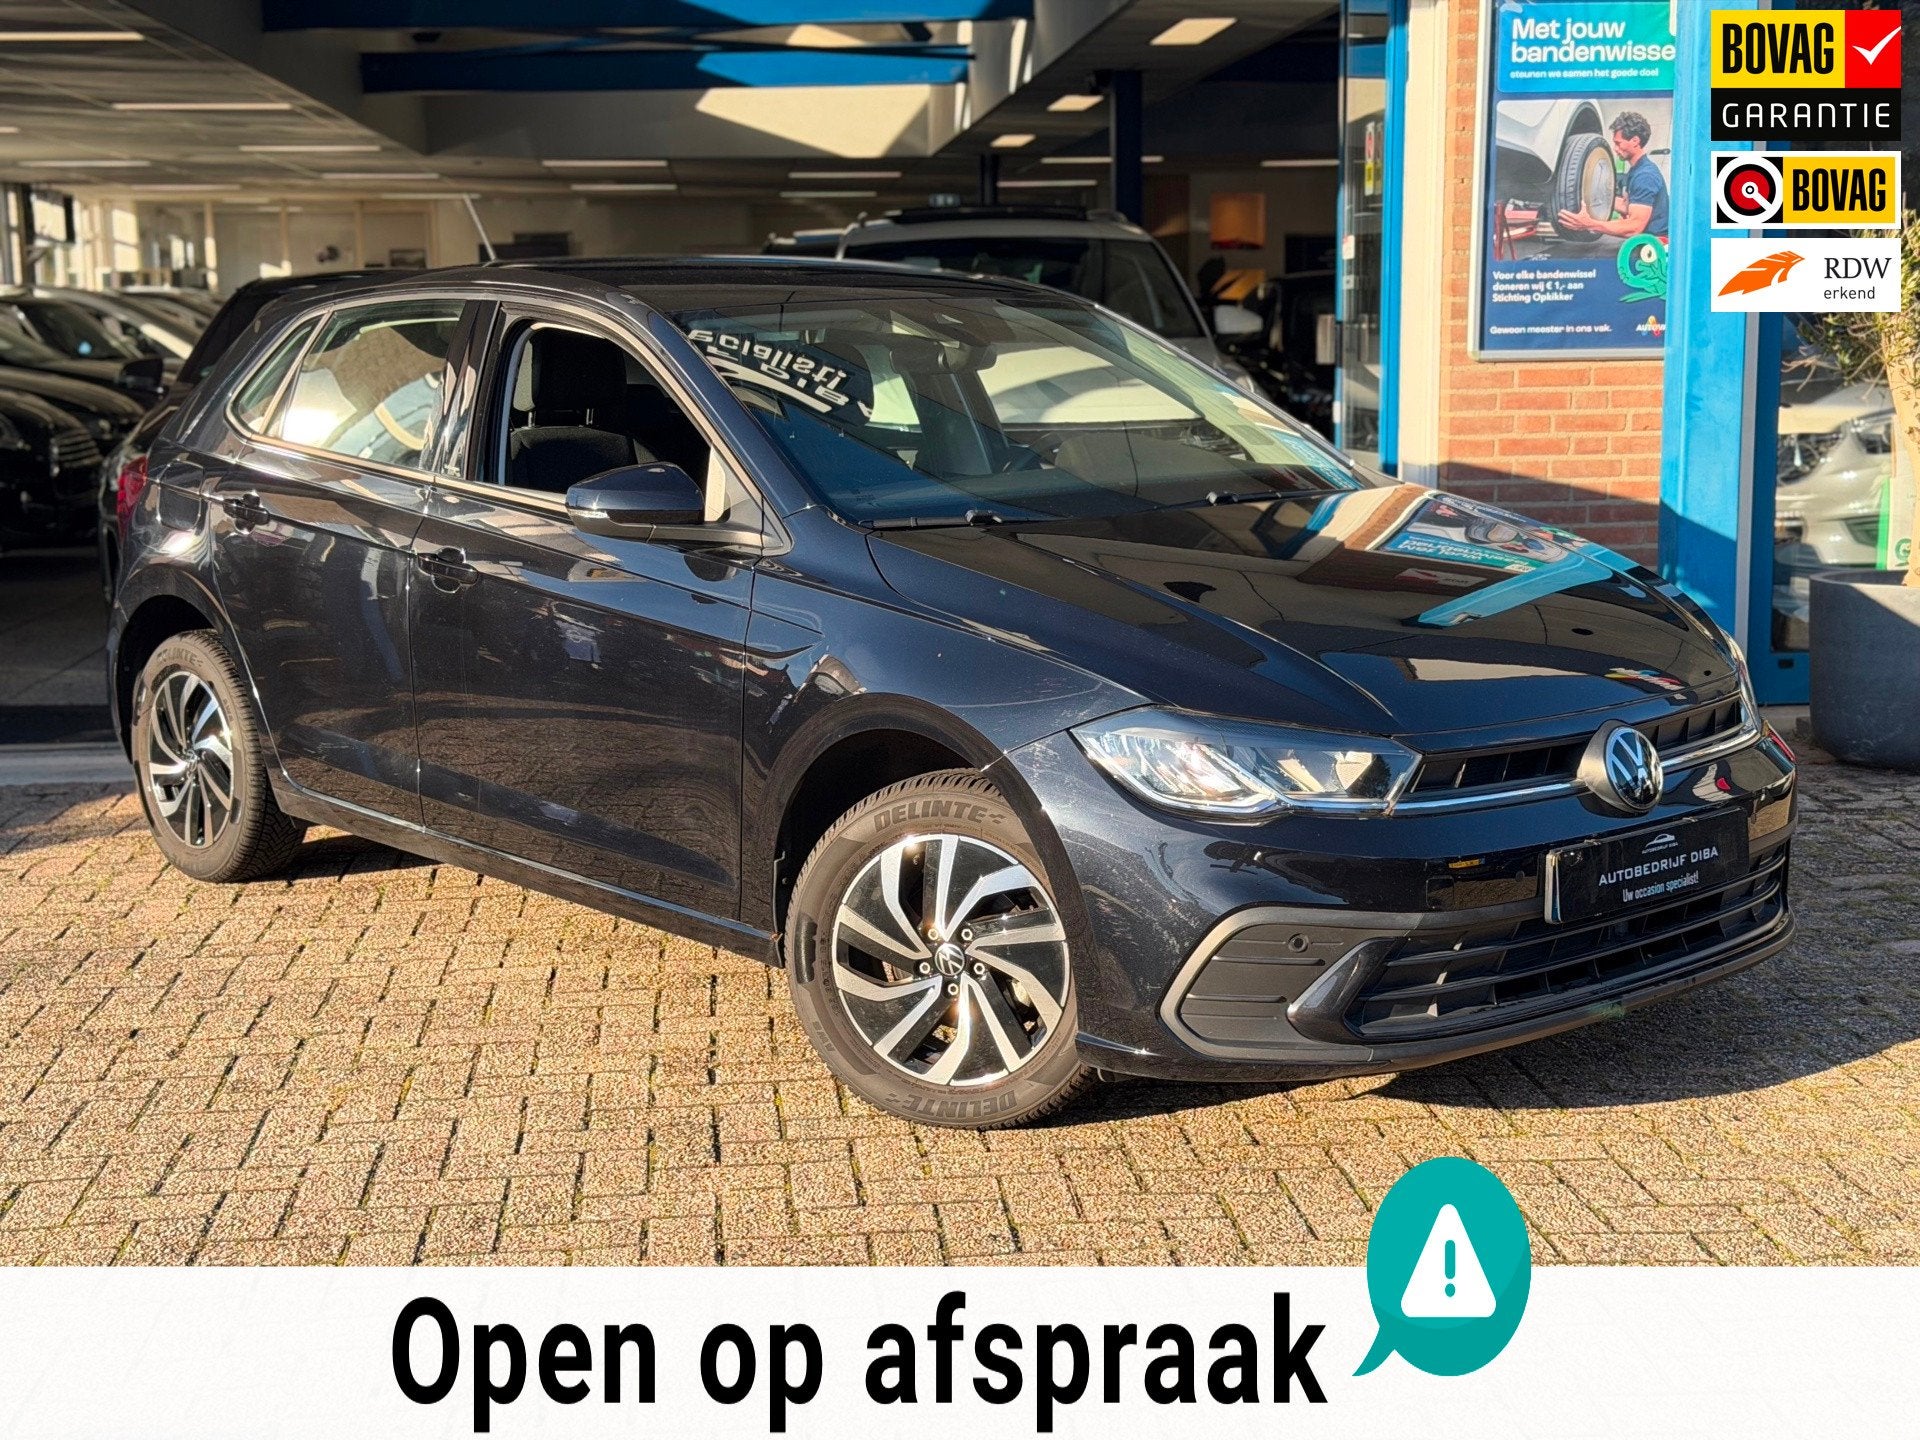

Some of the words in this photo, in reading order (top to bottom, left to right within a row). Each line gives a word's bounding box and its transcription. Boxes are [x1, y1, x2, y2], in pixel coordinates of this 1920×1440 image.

[1512, 18, 1561, 39] Met
[1562, 17, 1626, 45] jouw
[1510, 70, 1547, 79] steunen
[1562, 70, 1593, 78] samen
[1594, 68, 1610, 78] het
[1610, 68, 1638, 79] goede
[1639, 68, 1659, 77] doel
[1492, 271, 1514, 280] Voor
[1515, 270, 1535, 280] elke
[1536, 269, 1597, 279] bandenwissel
[1492, 282, 1530, 291] doneren
[1531, 282, 1545, 292] wij
[1567, 282, 1584, 290] aan
[1492, 292, 1531, 303] Stichting
[1532, 292, 1574, 302] Opkikker
[1489, 325, 1526, 335] Gewoon
[1527, 324, 1564, 334] meester
[1565, 324, 1575, 333] in
[1575, 325, 1592, 333] ons
[1593, 323, 1613, 333] vak.
[874, 800, 988, 833] DELINTE
[1598, 853, 1688, 886] AUTOBEDRIJF
[1690, 846, 1719, 863] DIBA
[1622, 888, 1634, 903] Uw
[1634, 882, 1665, 899] occasion
[1665, 870, 1699, 893] specialist!
[904, 1090, 1018, 1119] DELINTE
